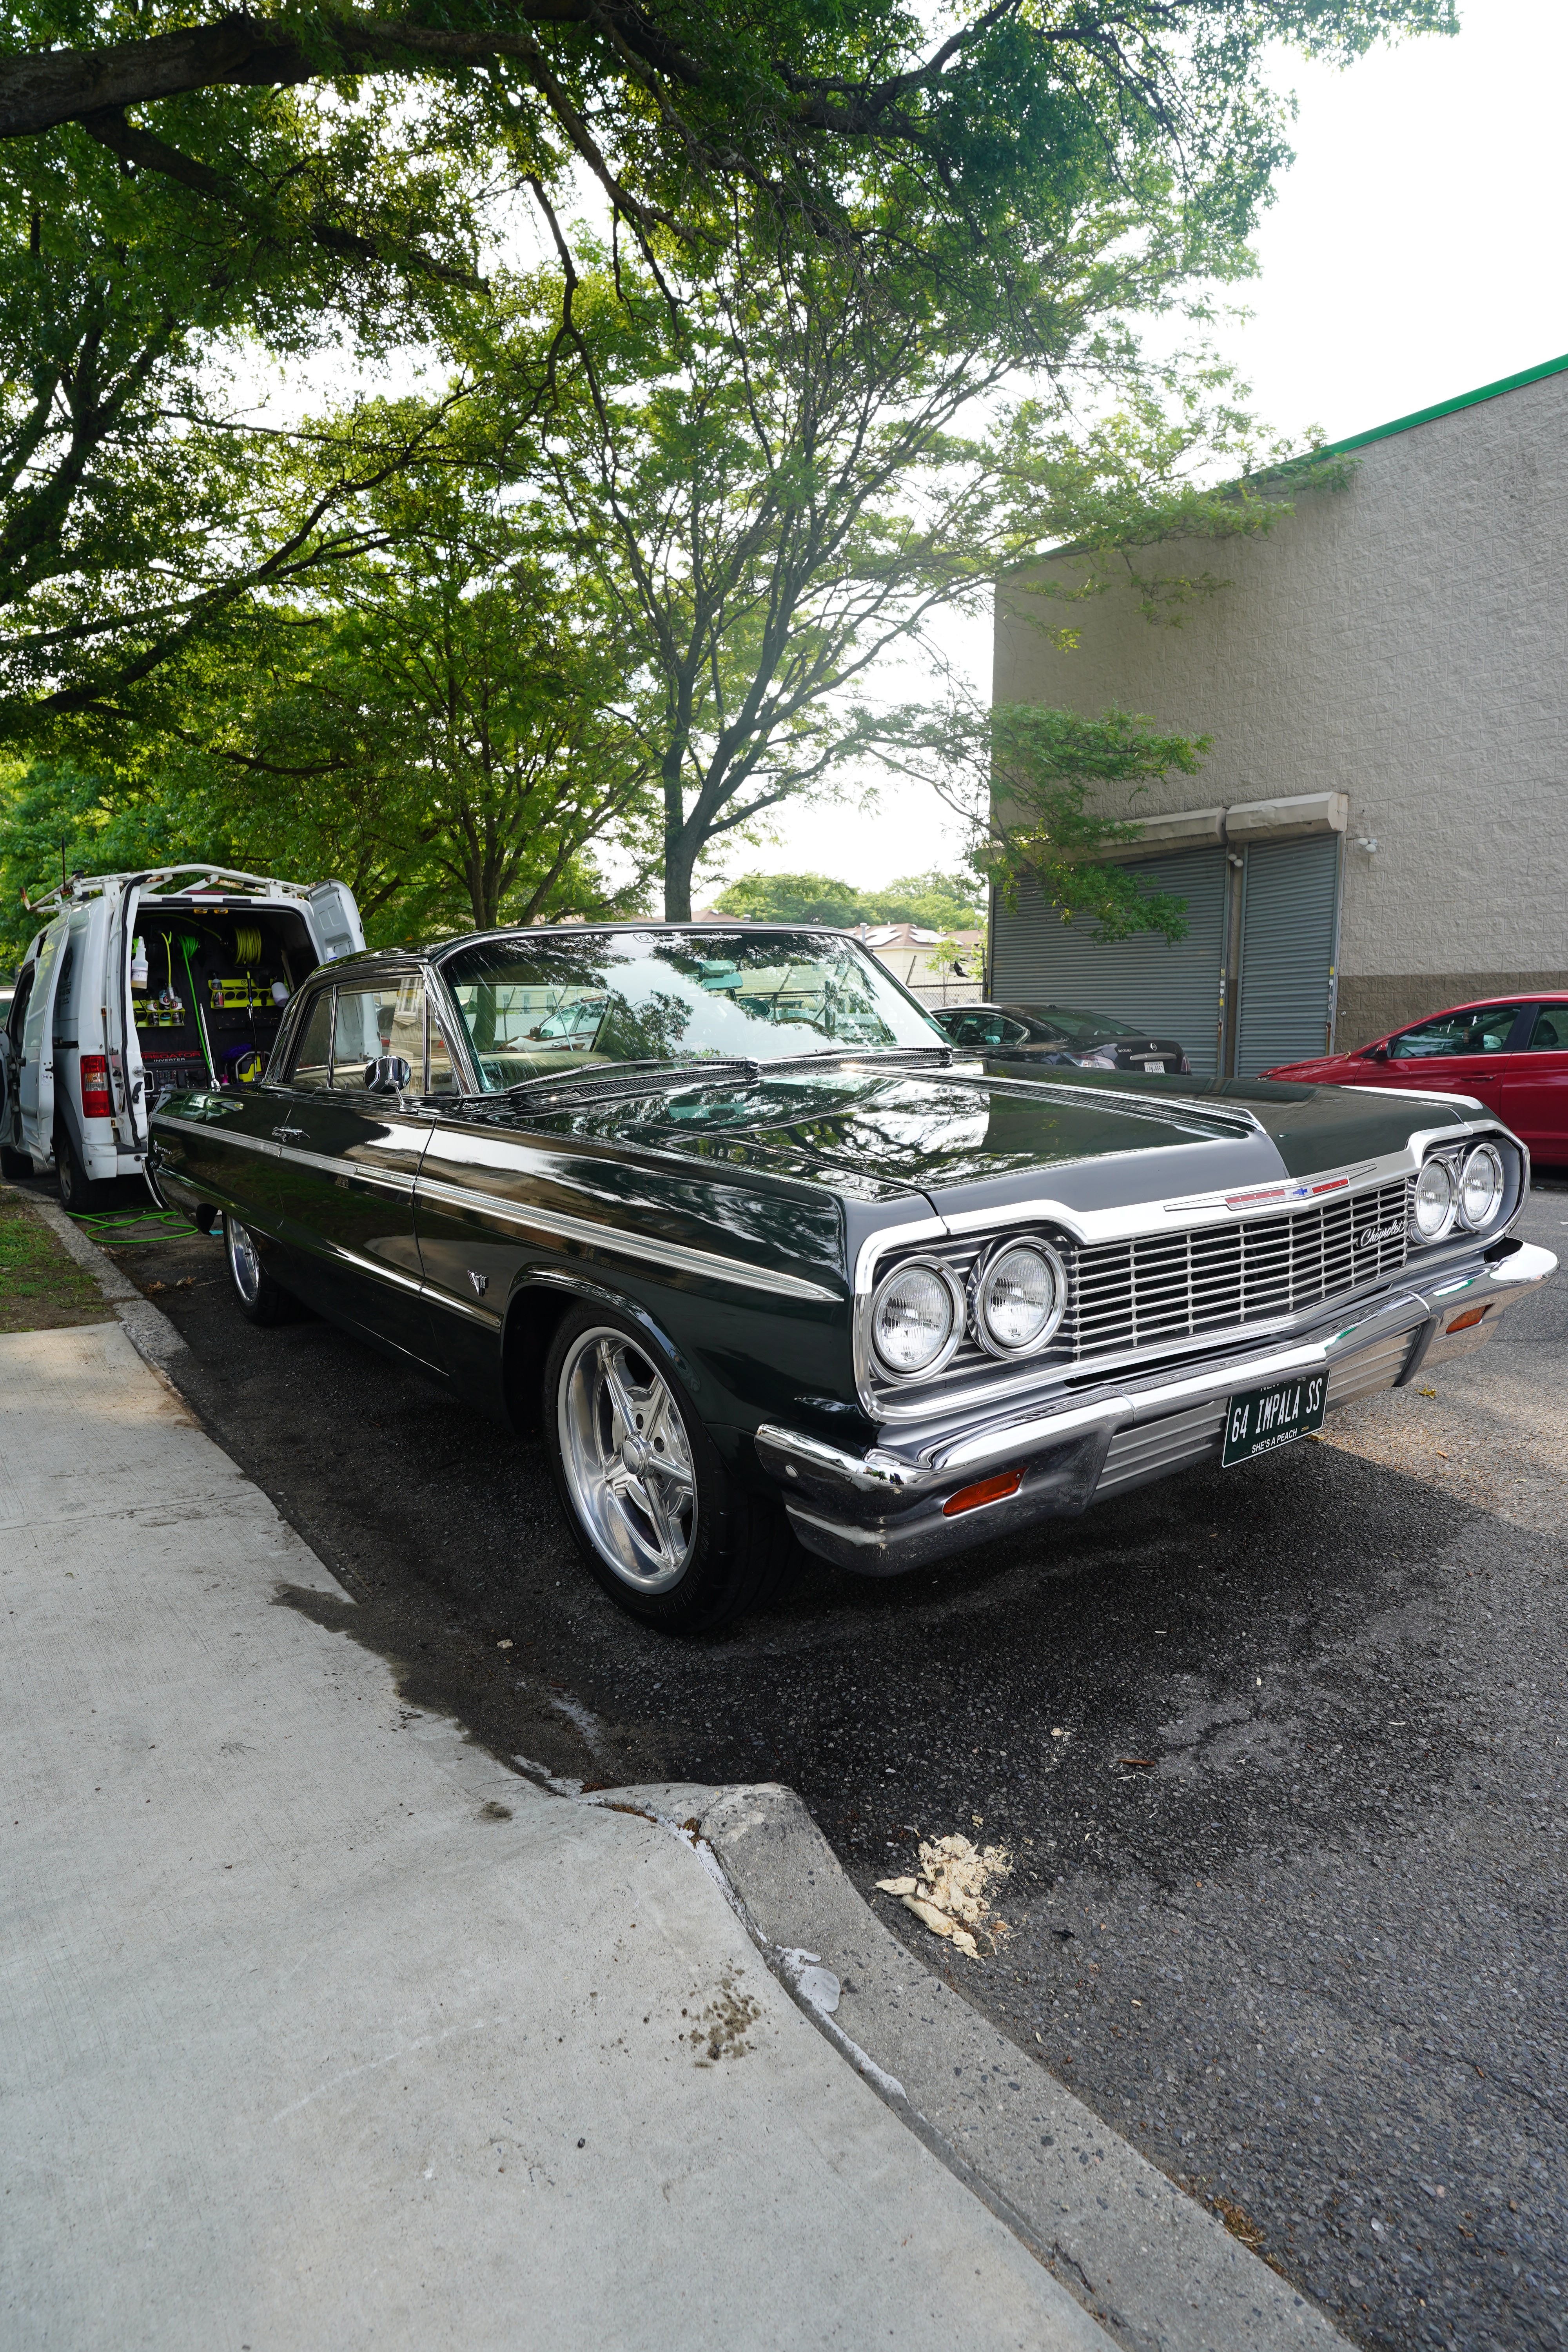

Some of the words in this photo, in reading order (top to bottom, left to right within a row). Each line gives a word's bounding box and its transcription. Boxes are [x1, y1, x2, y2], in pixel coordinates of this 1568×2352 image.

[1360, 1220, 1405, 1247] Chevrolet
[1232, 1404, 1249, 1442] 64
[1255, 1386, 1300, 1434] IMPALA
[1306, 1377, 1322, 1414] SS
[1252, 1439, 1270, 1453] SHE'S
[1270, 1437, 1276, 1446] A
[1276, 1428, 1298, 1443] PEACH
